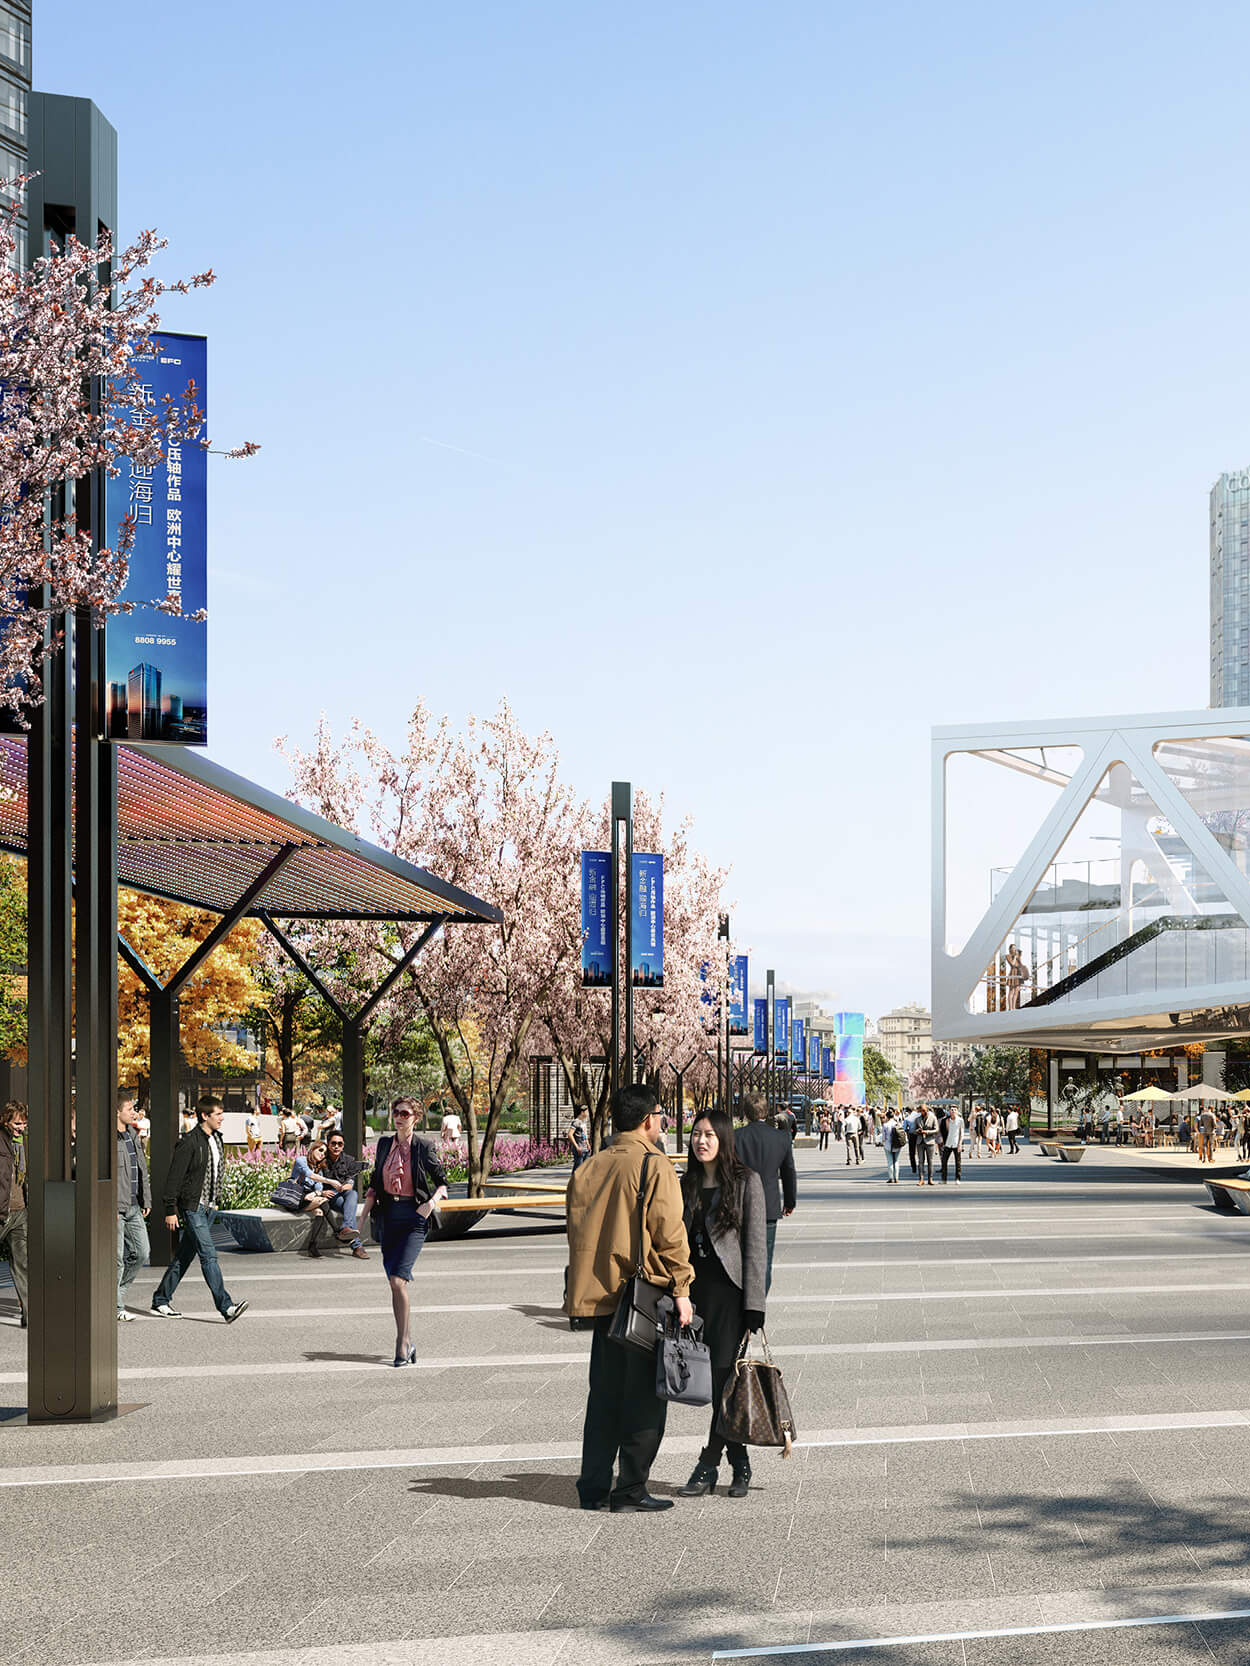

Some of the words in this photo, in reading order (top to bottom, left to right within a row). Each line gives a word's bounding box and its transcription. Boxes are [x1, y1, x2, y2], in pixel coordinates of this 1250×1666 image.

[166, 508, 182, 616] 欧洲中心耀世
